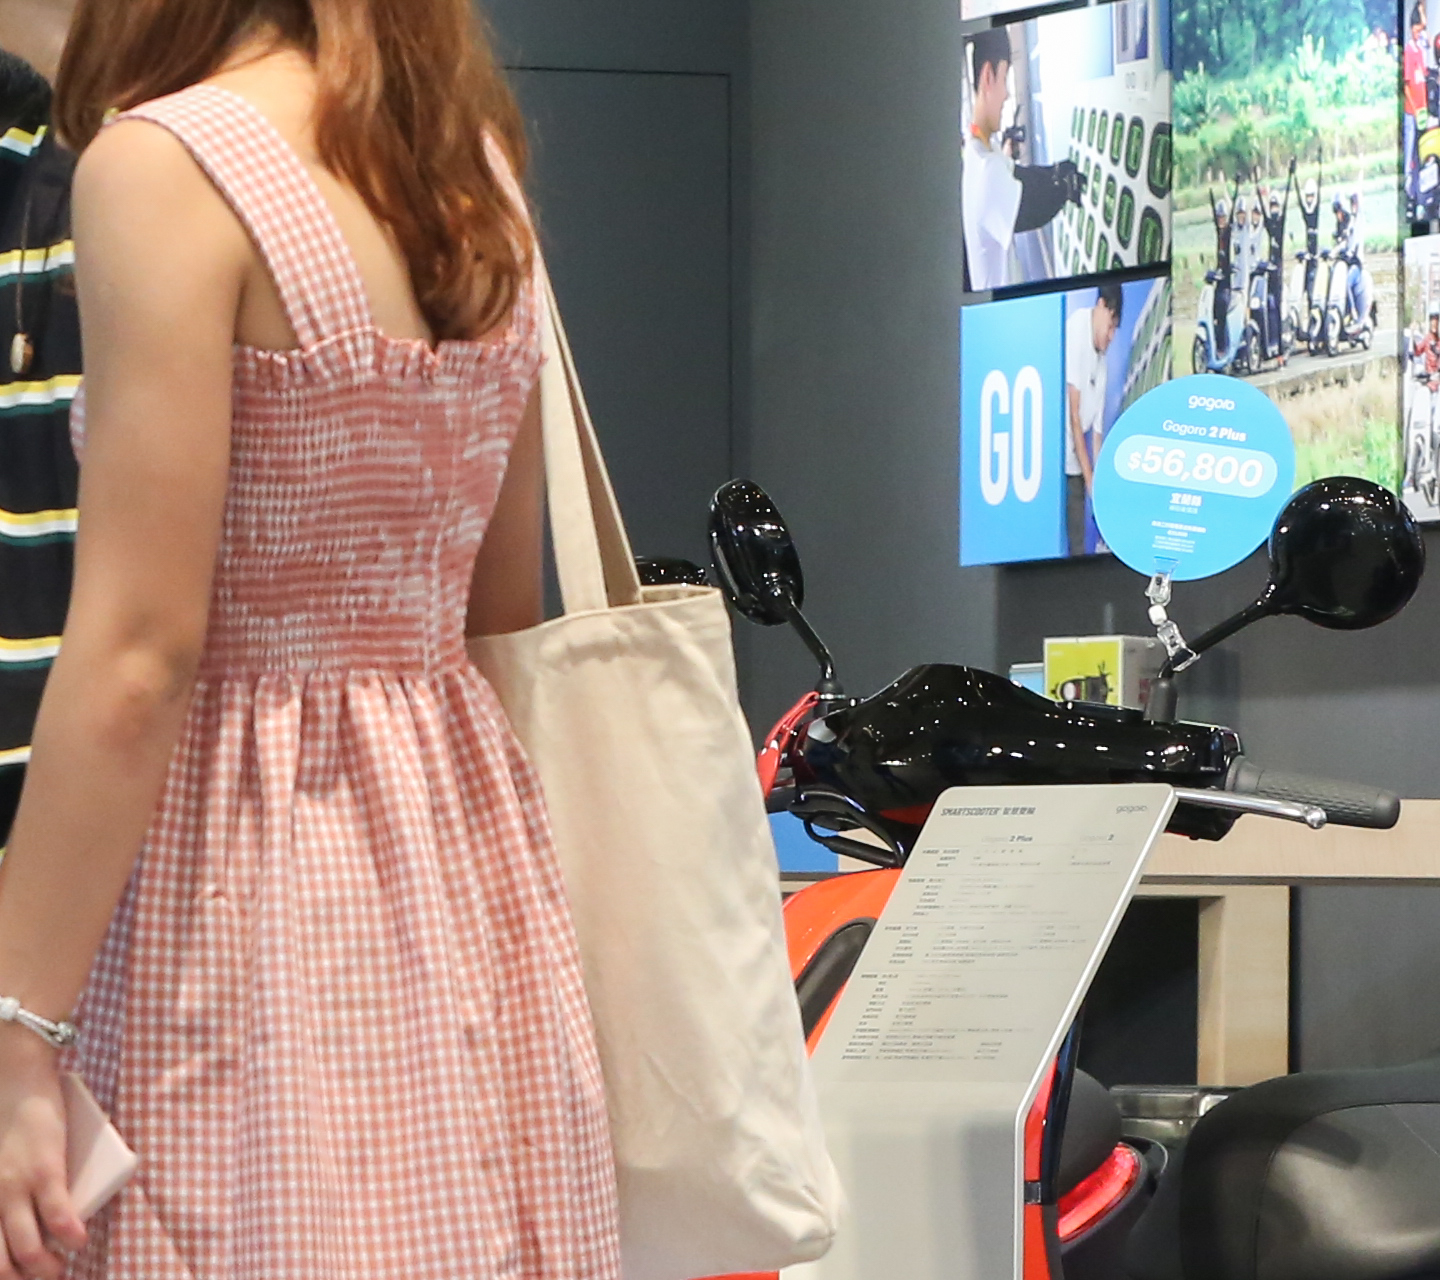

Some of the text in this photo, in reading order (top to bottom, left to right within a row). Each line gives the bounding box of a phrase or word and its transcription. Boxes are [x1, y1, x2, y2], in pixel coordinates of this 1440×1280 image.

[1188, 395, 1235, 412] gogoro
[980, 365, 1043, 506] GO
[1162, 419, 1247, 442] Gogoro 2 Plus
[1127, 445, 1264, 488] $56,800
